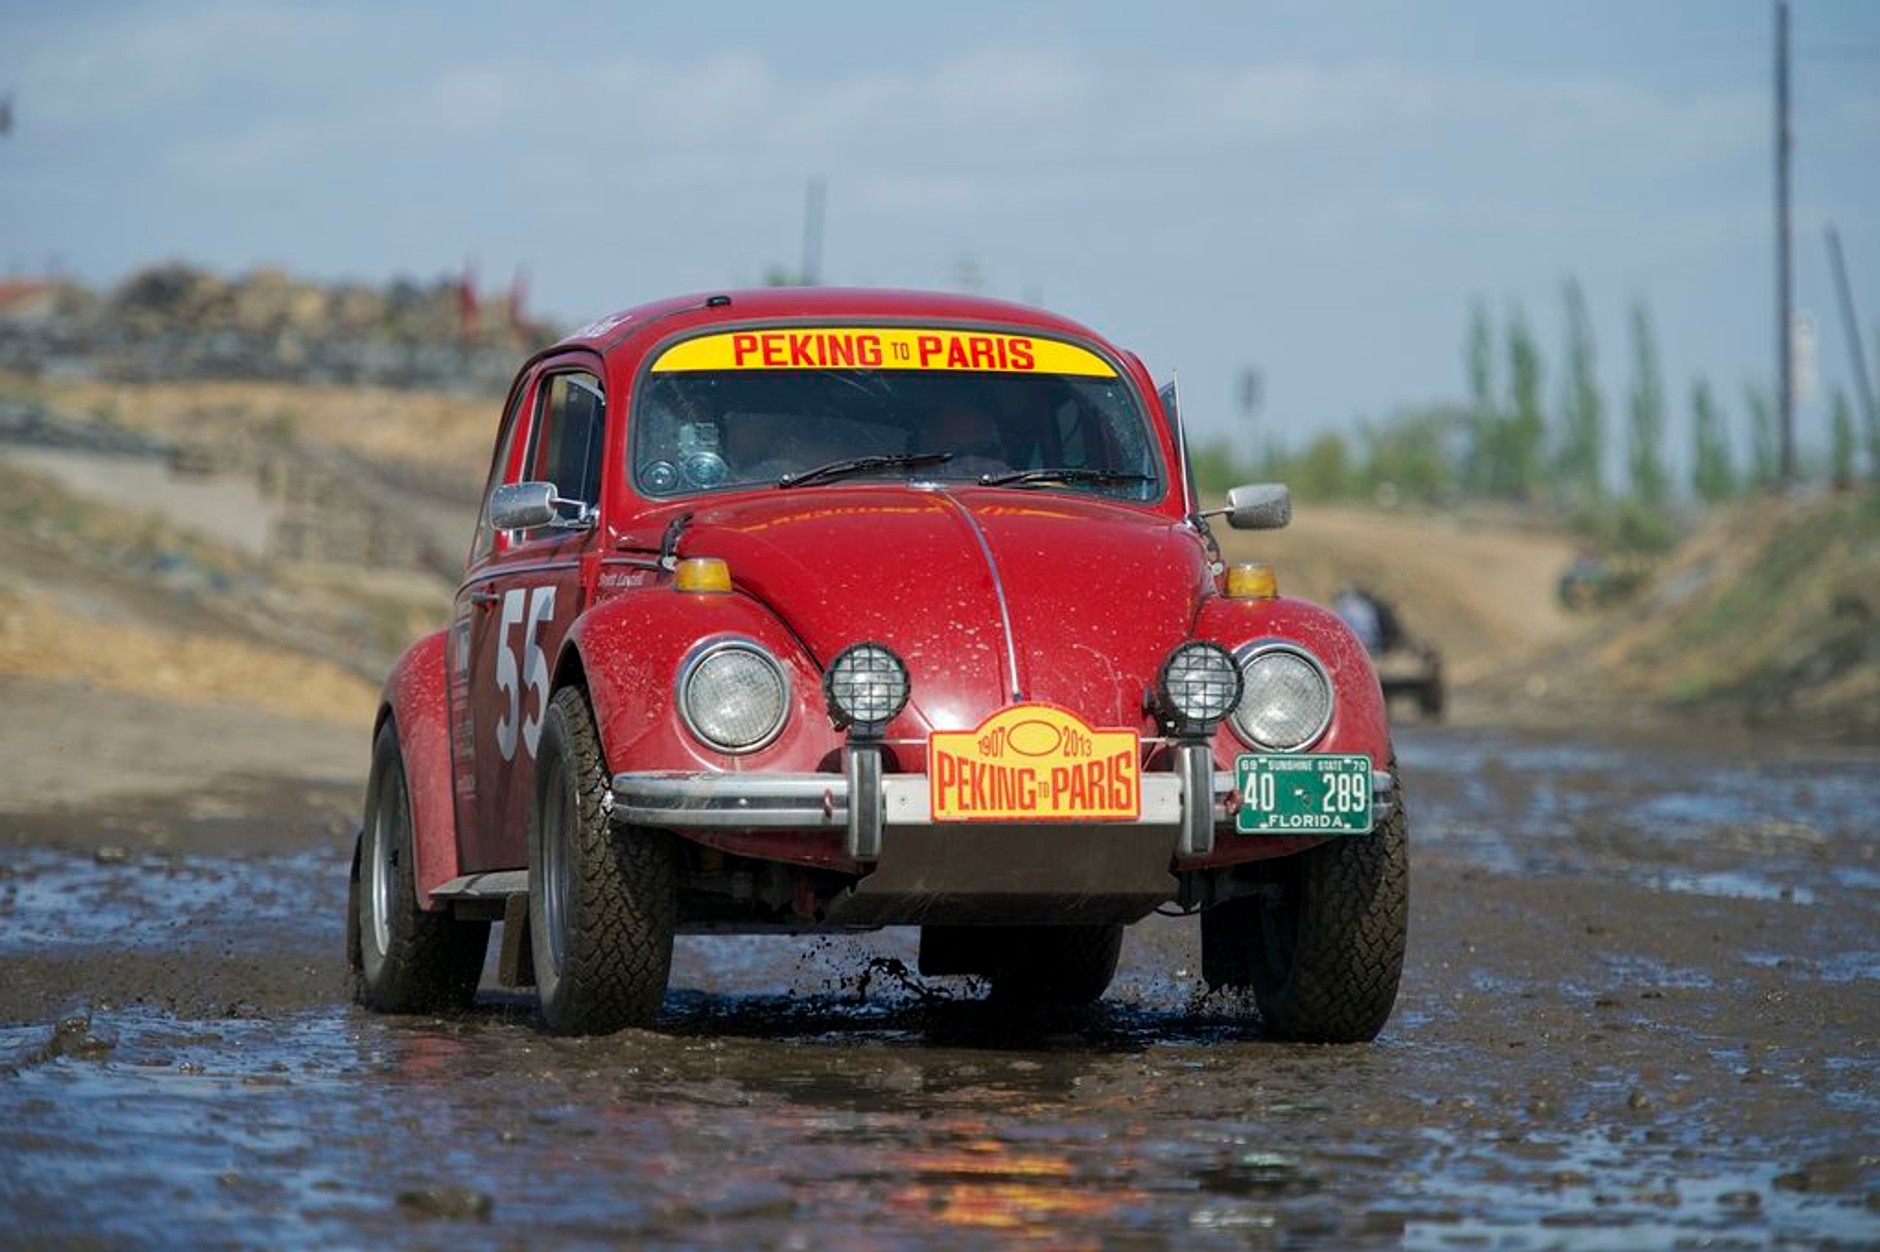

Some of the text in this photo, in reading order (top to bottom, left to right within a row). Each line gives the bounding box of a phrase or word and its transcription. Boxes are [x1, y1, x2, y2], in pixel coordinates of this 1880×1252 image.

[733, 334, 1035, 370] PEKING TO PARIS
[497, 586, 556, 761] 55
[978, 726, 1005, 758] 1907
[1063, 726, 1092, 757] 2013
[937, 751, 1132, 810] PEKING TO PARIS
[1241, 760, 1366, 772] 69 SUNSHINE STATE 70
[1244, 773, 1366, 812] 40 289
[1269, 815, 1343, 828] FLORIDA
